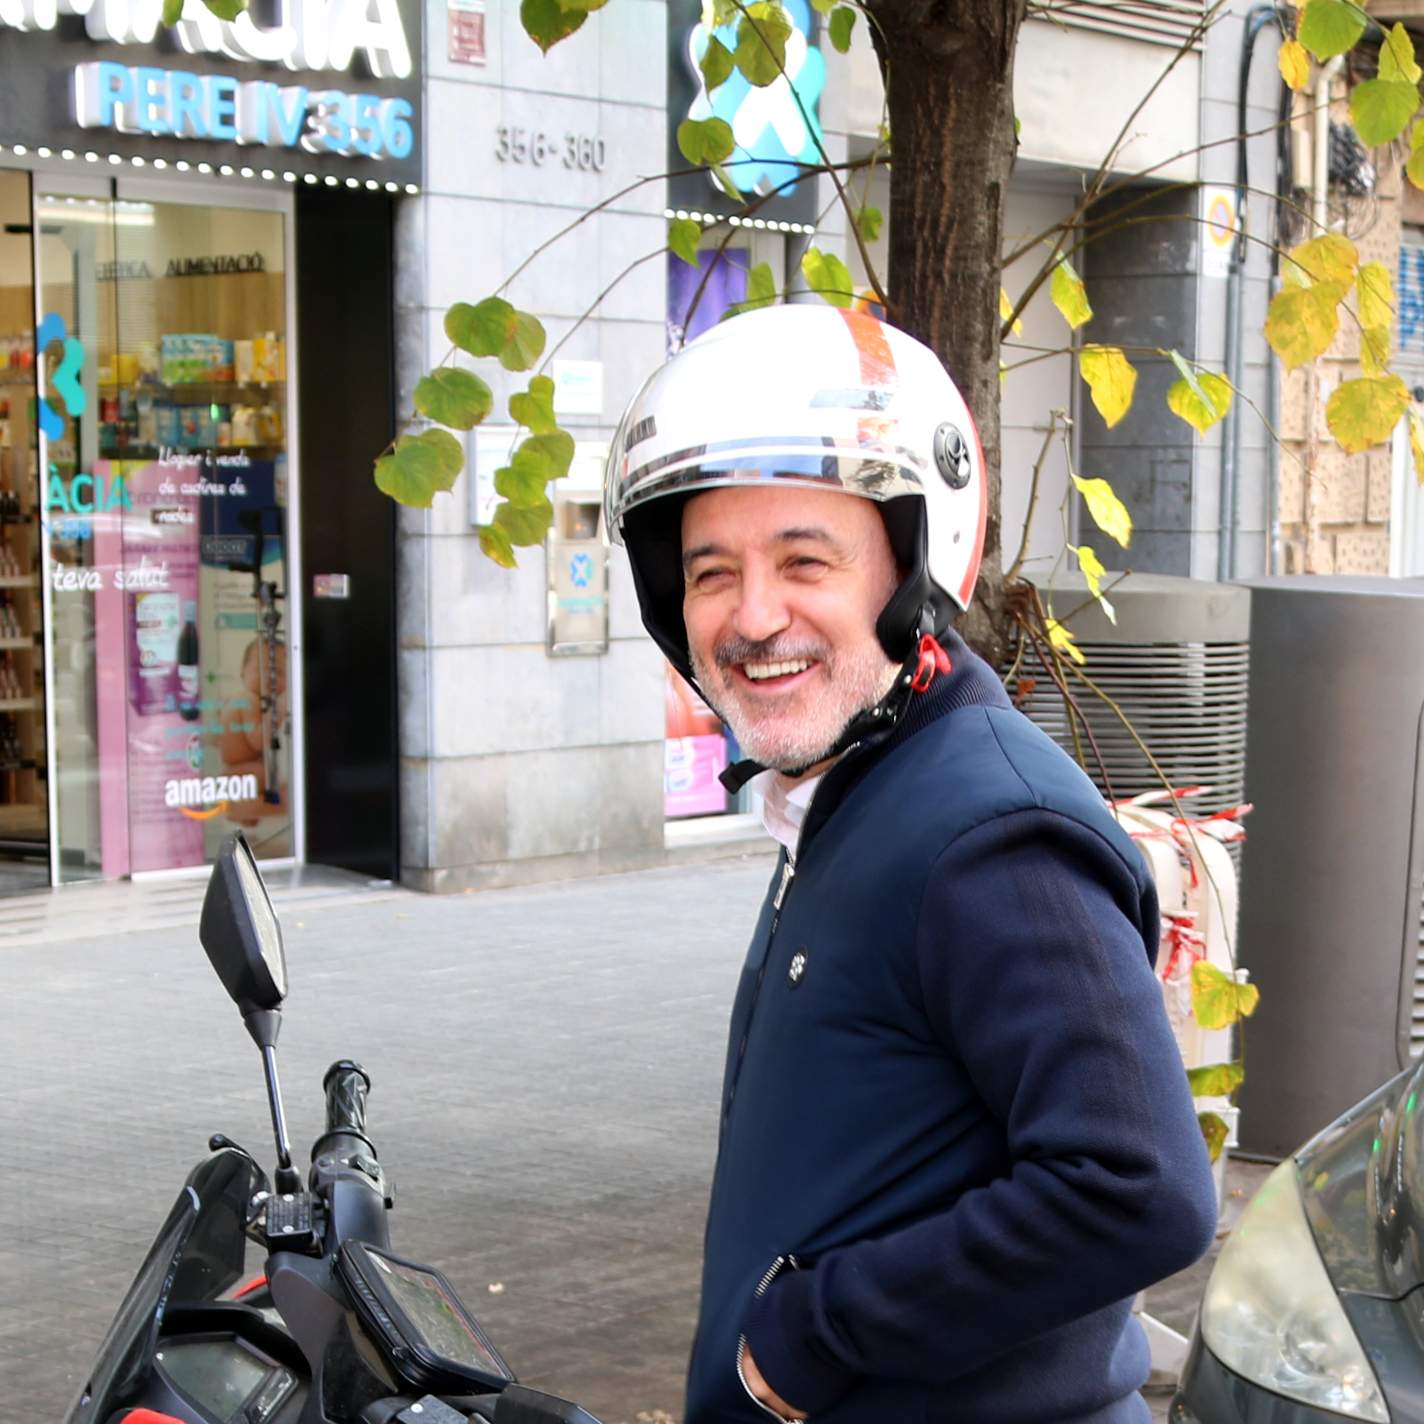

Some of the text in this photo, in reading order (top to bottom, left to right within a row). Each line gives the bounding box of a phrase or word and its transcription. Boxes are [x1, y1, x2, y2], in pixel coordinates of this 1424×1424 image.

[86, 60, 414, 160] PERE IV 356
[494, 125, 607, 173] 356-360
[165, 251, 266, 278] ALIMENTACIÓ
[45, 463, 133, 513] ÀCIA
[53, 563, 104, 592] teva
[113, 555, 171, 589] salut
[164, 774, 258, 807] amazon
